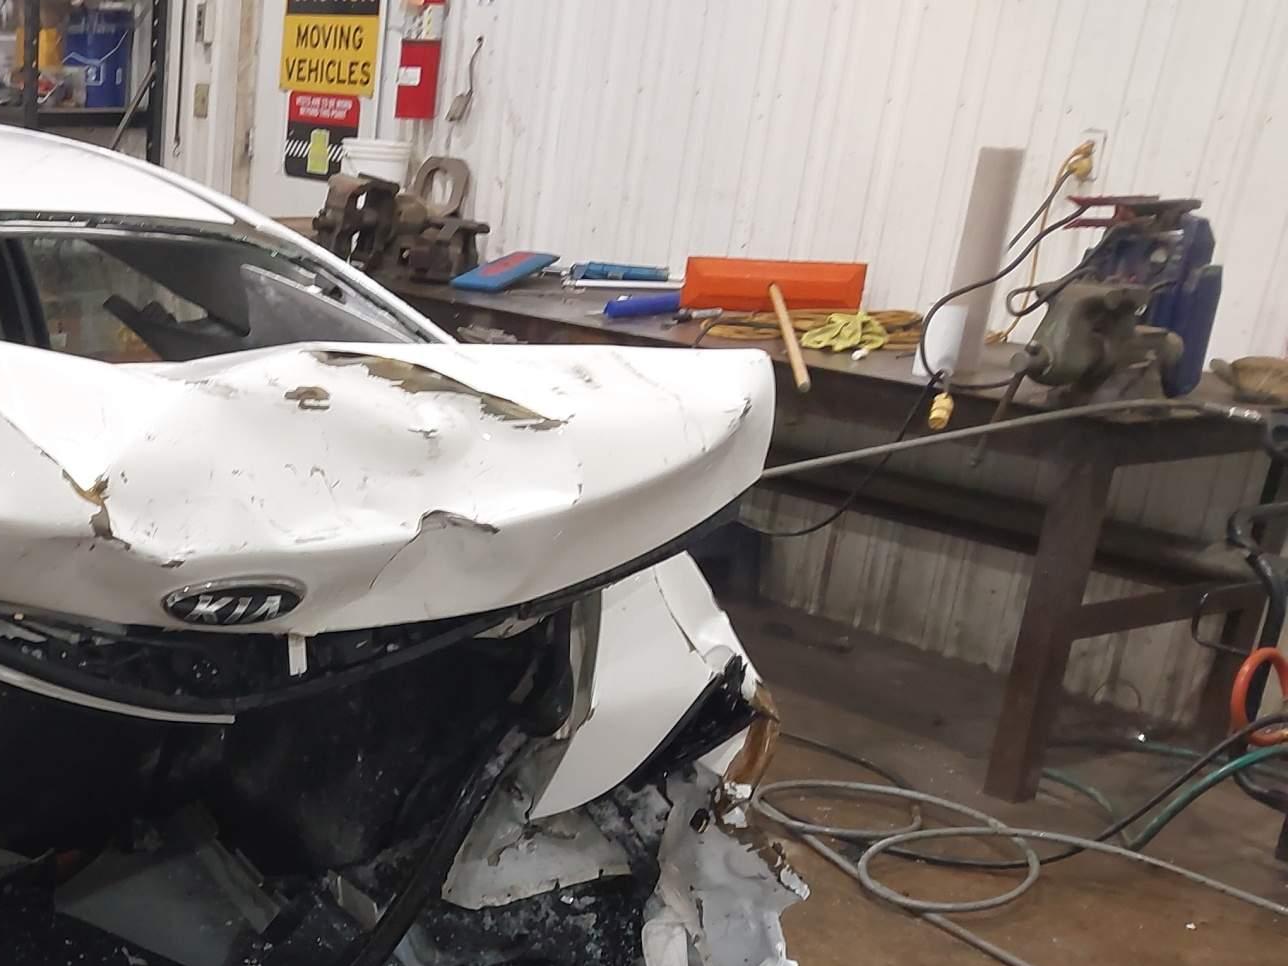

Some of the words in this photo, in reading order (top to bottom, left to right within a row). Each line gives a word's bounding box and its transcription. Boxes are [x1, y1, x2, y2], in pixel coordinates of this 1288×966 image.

[296, 24, 364, 50] MOVING
[285, 58, 372, 86] VEHICLES
[184, 594, 282, 625] KIA
